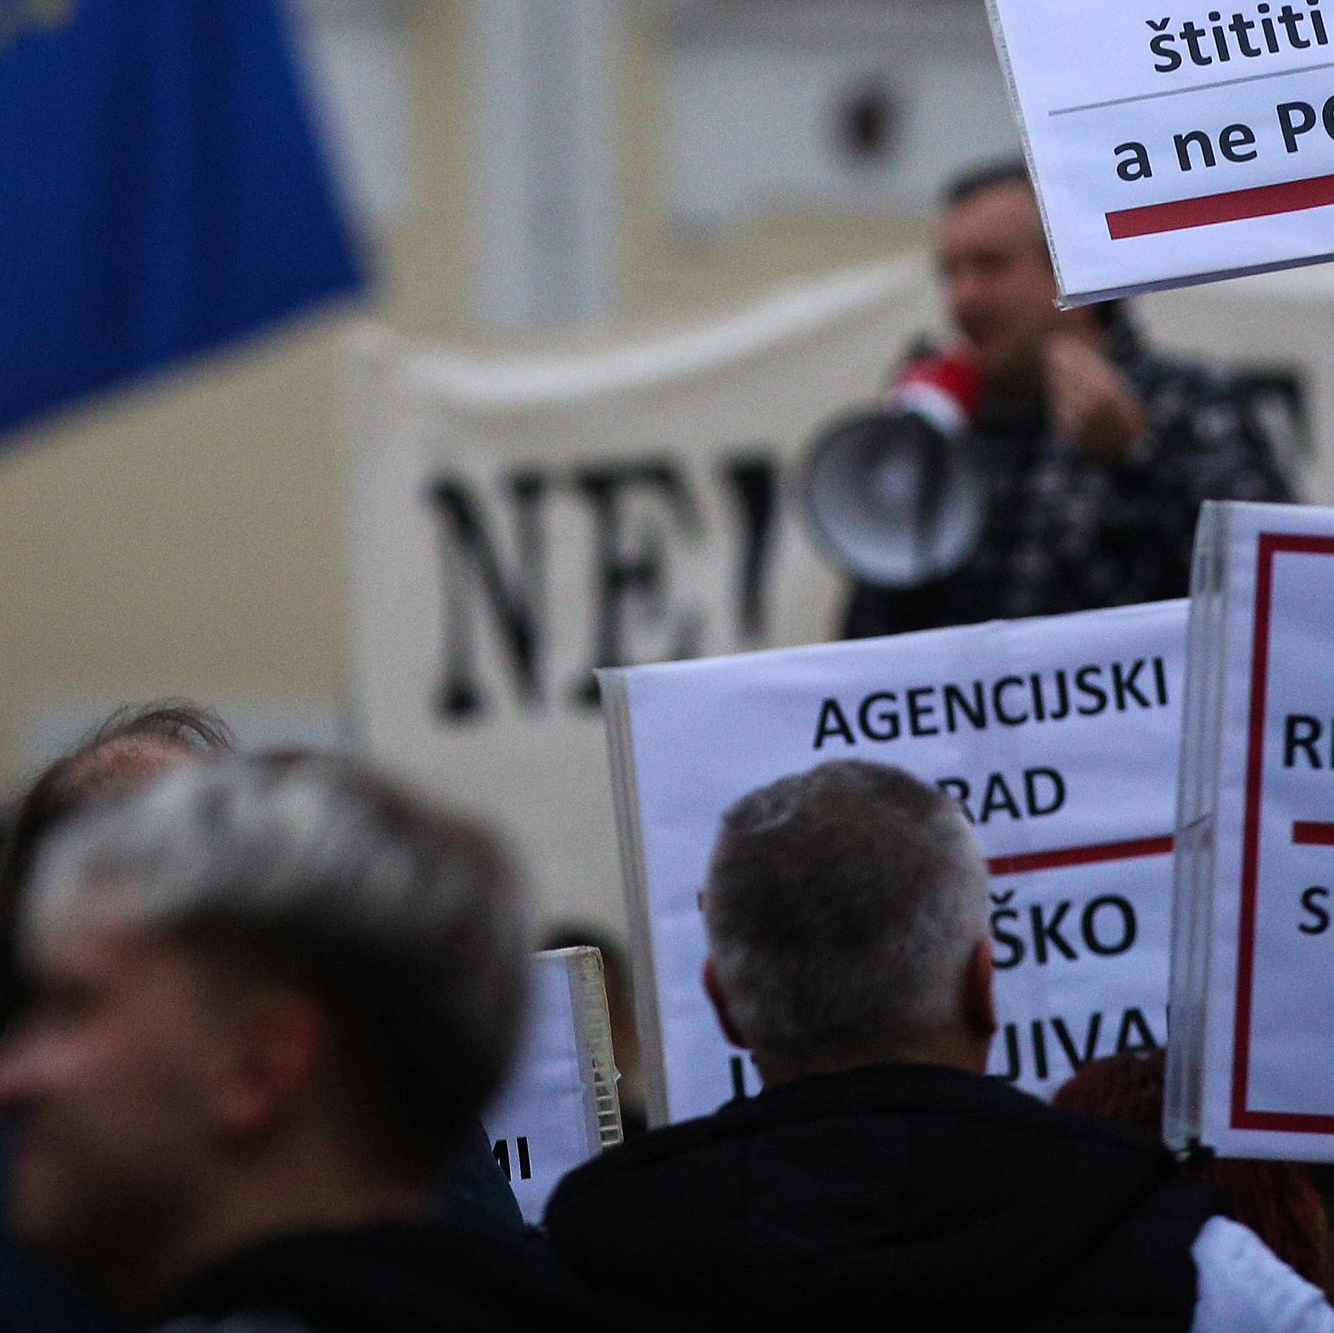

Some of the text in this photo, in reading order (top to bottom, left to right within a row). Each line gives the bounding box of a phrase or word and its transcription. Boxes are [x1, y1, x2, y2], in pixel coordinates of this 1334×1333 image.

[1114, 141, 1153, 182] a
[1173, 123, 1258, 172] ne
[813, 656, 1168, 749] AGENCIJSKI
